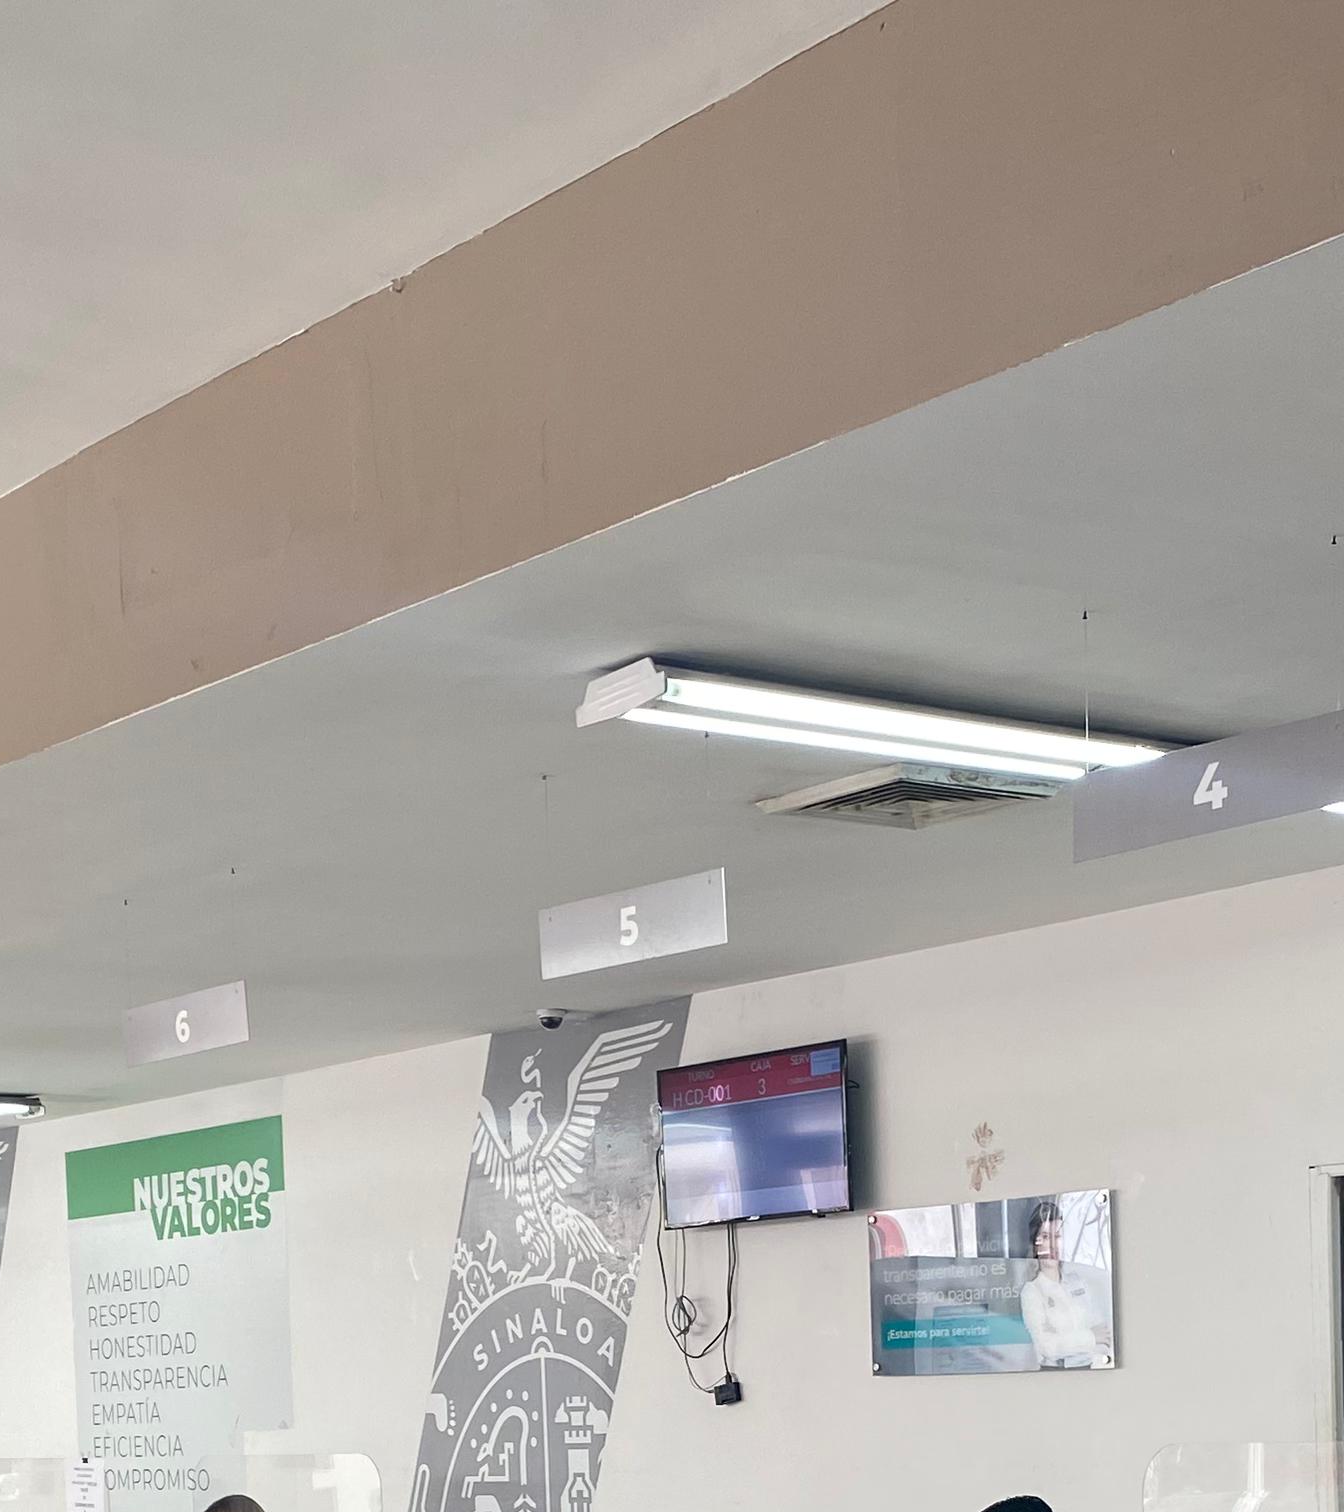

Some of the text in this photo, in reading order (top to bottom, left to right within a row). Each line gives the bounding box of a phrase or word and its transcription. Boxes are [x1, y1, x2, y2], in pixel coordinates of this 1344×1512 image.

[1193, 761, 1228, 810] 4
[619, 905, 639, 946] 5
[175, 1010, 190, 1043] 6
[750, 1059, 772, 1073] CAJA
[758, 1078, 767, 1096] 3
[133, 1157, 271, 1211] NUESTROS
[151, 1192, 272, 1241] VALORES
[86, 1263, 191, 1295] AMABILIDAD
[992, 1263, 1007, 1275] es
[948, 1287, 986, 1304] pagar
[88, 1300, 161, 1328] RESPETO
[88, 1331, 197, 1361] HONESTIDAD
[472, 1307, 616, 1372] SINALOA
[930, 1327, 949, 1339] para
[90, 1364, 229, 1393] TRANSPARENCIA
[91, 1397, 162, 1426] EMPATÍA
[93, 1434, 185, 1459] EFICIENCIA
[104, 1468, 211, 1492] OMPROMISO
